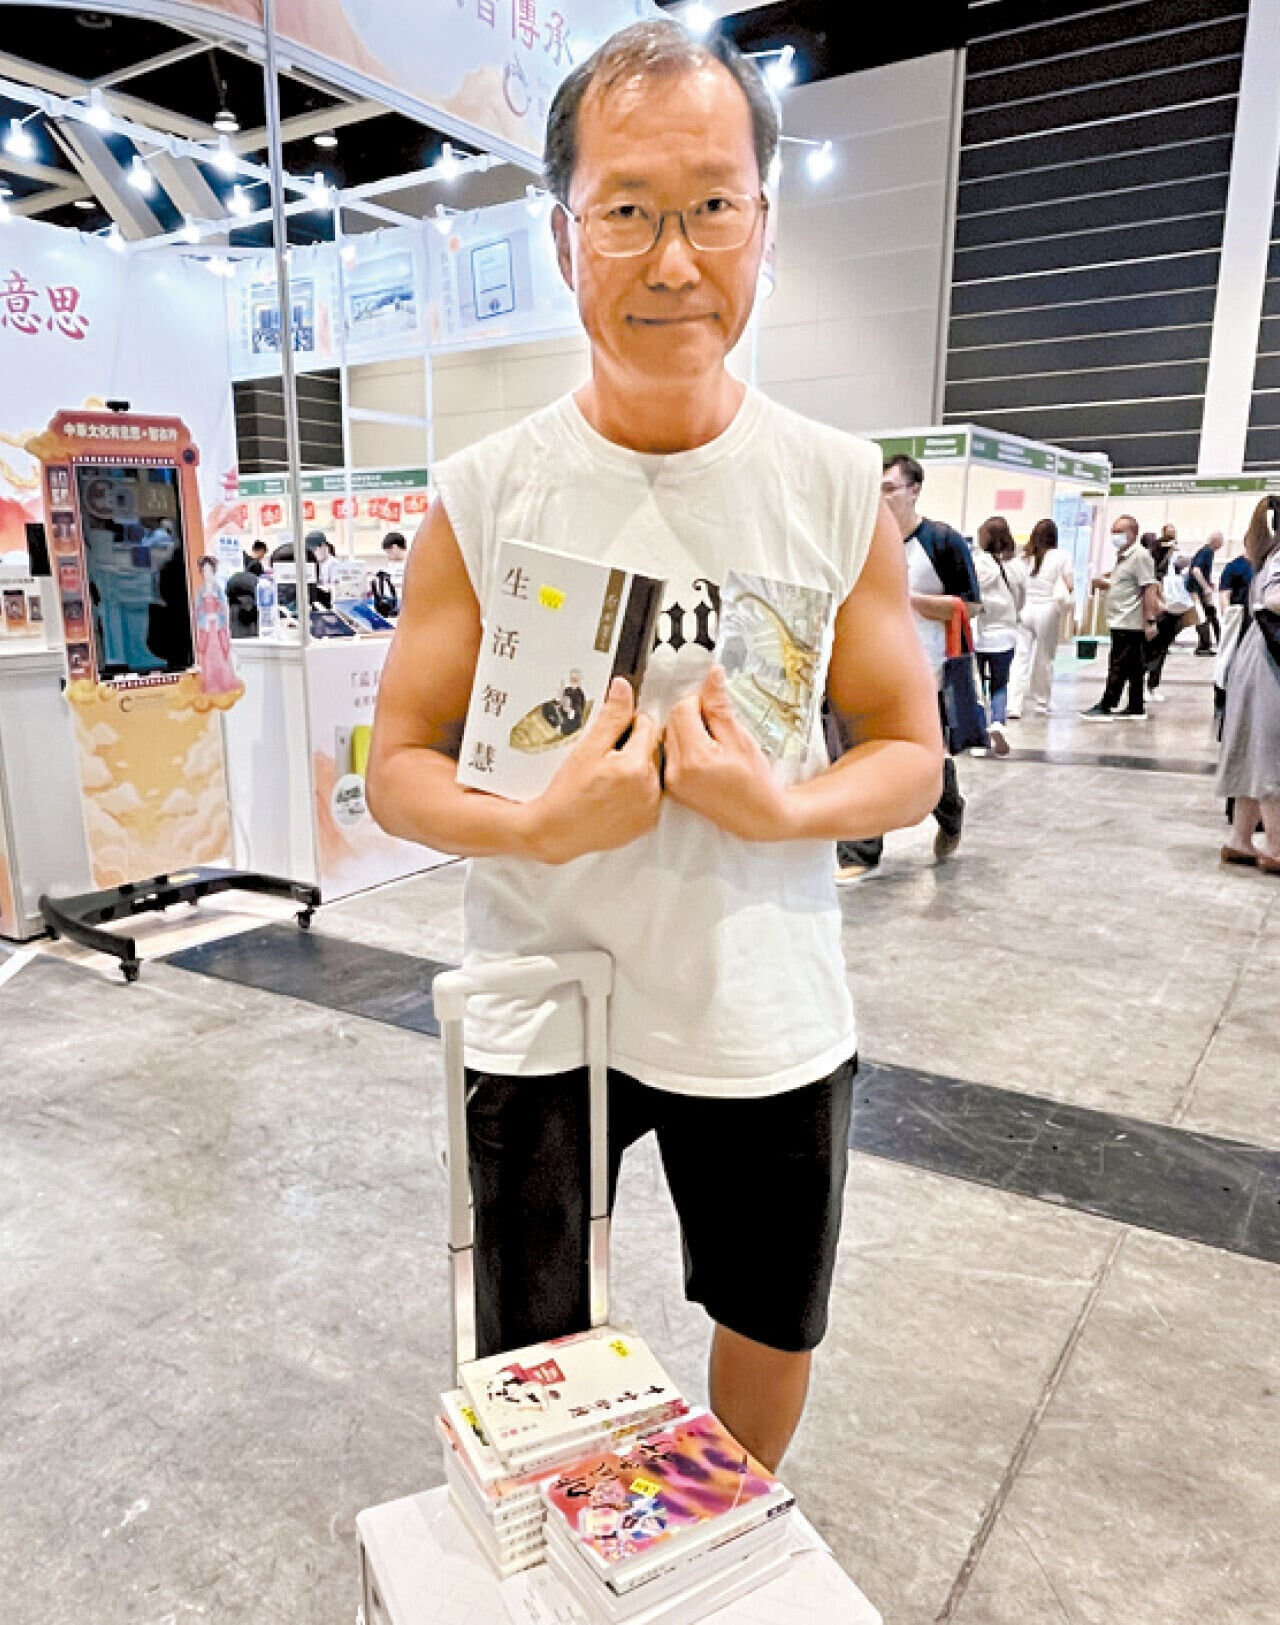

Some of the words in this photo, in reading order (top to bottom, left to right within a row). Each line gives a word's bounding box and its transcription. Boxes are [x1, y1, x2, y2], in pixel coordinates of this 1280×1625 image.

[0, 270, 89, 340] 意思
[468, 566, 531, 774] 生活智慧
